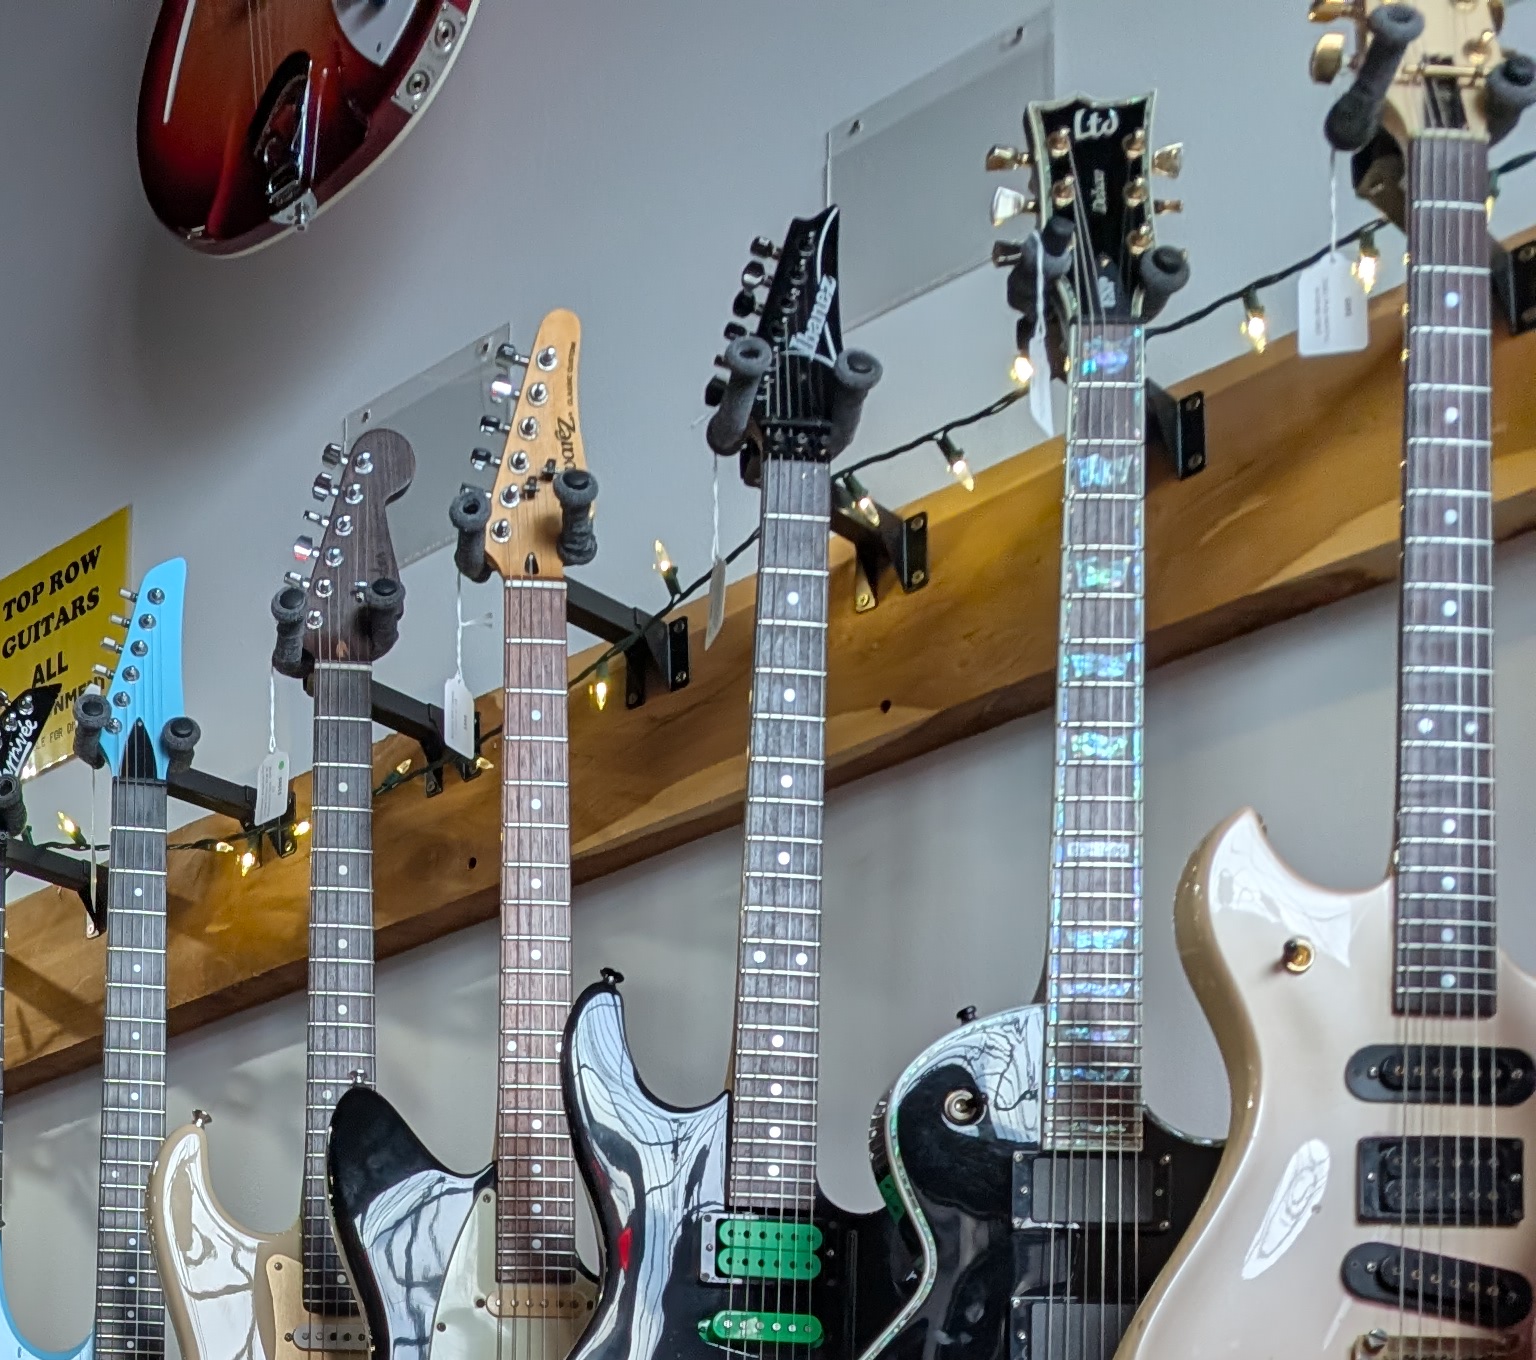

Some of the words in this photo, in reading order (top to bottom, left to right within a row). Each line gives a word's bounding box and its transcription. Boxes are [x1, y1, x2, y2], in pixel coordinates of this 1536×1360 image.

[789, 274, 837, 355] Ibanez
[2, 581, 45, 622] TOP
[48, 545, 103, 596] ROW
[1, 585, 101, 660] GUITARS
[32, 650, 69, 689] ALL
